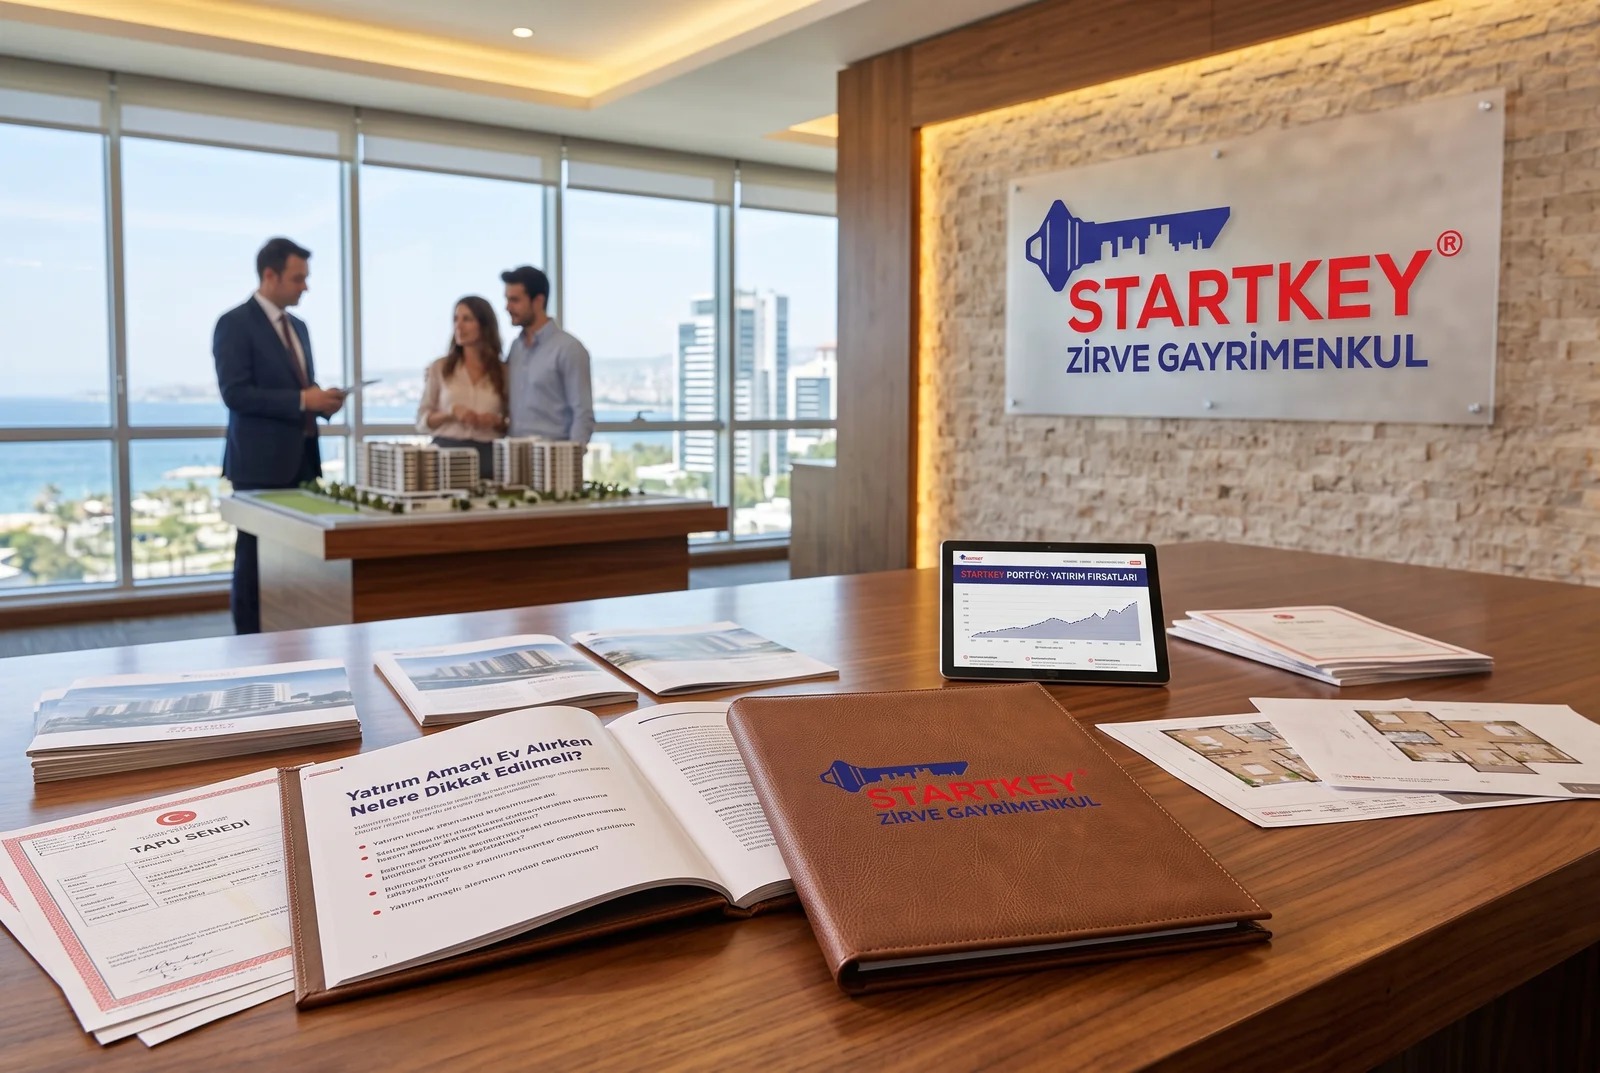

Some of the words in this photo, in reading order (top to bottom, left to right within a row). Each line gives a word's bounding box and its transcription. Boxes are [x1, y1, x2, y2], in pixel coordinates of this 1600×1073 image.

[1067, 249, 1432, 333] STARTKEY
[1066, 338, 1149, 374] ZİRVE
[1157, 330, 1428, 373] GAYRİMENKUL
[961, 570, 1005, 579] STARTKEY
[1006, 569, 1049, 580] PORTFÖY:
[1050, 571, 1086, 580] YATIRIM
[1087, 572, 1138, 582] FIRSATLARI
[346, 776, 421, 802] Yatırım
[426, 756, 493, 782] Amaçlı
[497, 749, 520, 763] Ev
[527, 738, 593, 755] Alırken
[350, 792, 419, 818] Nelere
[424, 771, 491, 798] Dikkat
[494, 750, 582, 778] Edilmeli?
[867, 772, 1076, 809] STARTKEY
[876, 809, 944, 826] ZİRVE
[946, 795, 1102, 819] GAYRİMENKUL
[129, 837, 181, 854] TAPU
